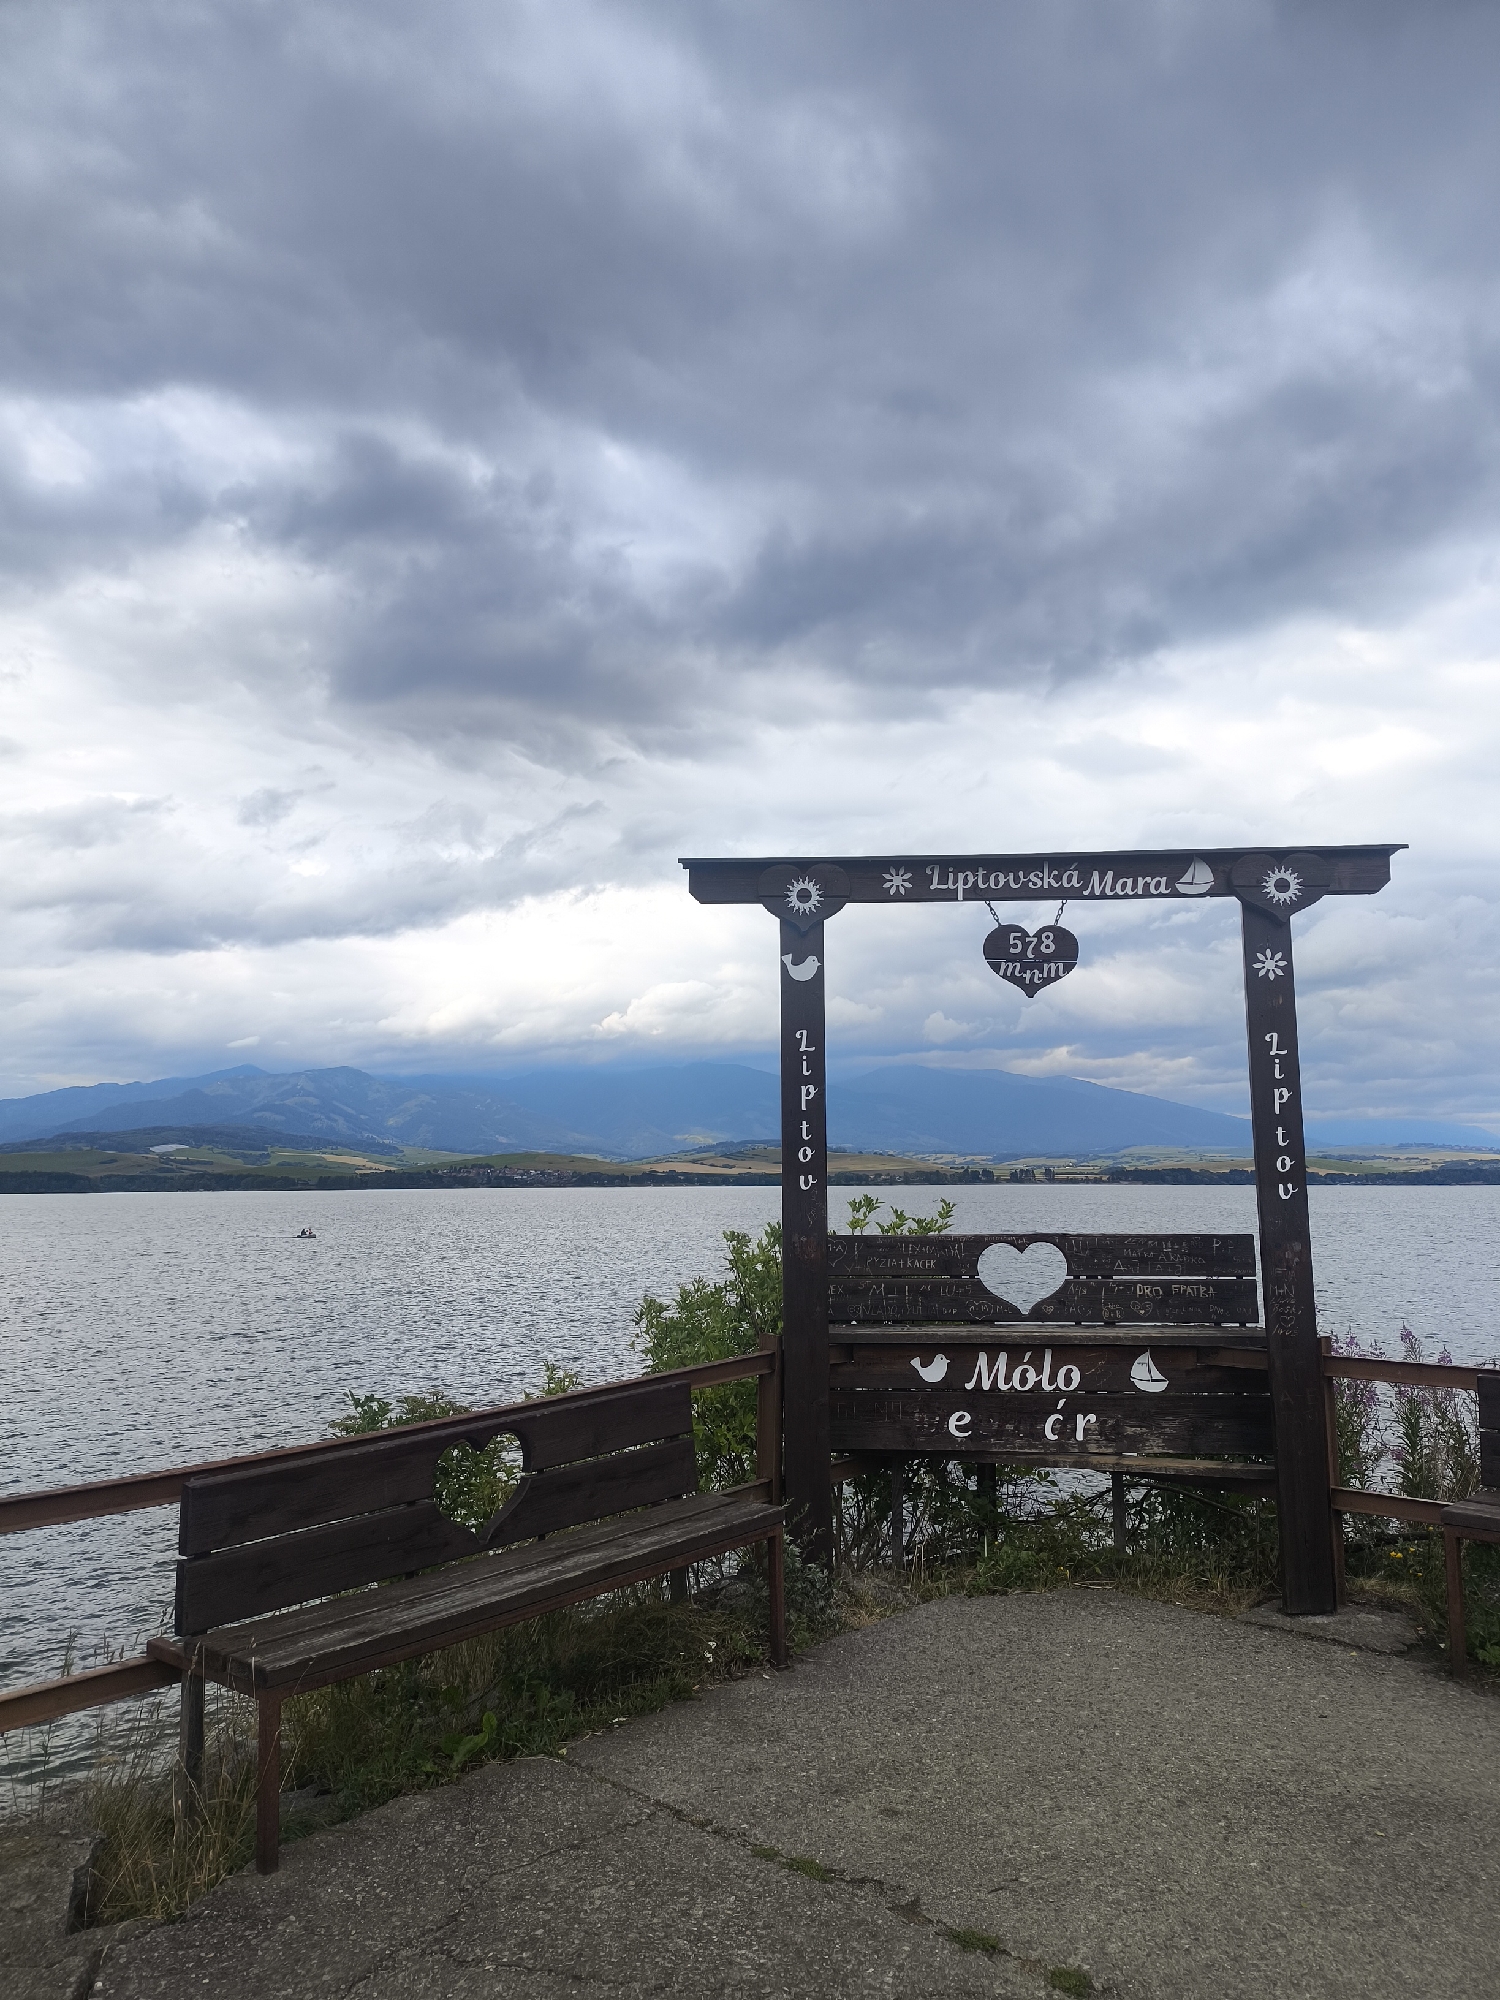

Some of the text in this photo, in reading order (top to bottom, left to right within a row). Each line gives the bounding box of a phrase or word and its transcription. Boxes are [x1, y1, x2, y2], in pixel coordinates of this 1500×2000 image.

[926, 861, 1172, 900] Liptovská Mara
[1009, 932, 1055, 958] 578
[796, 1029, 818, 1190] Liptov
[1265, 1032, 1298, 1200] Liptov
[965, 1349, 1081, 1391] Mólo
